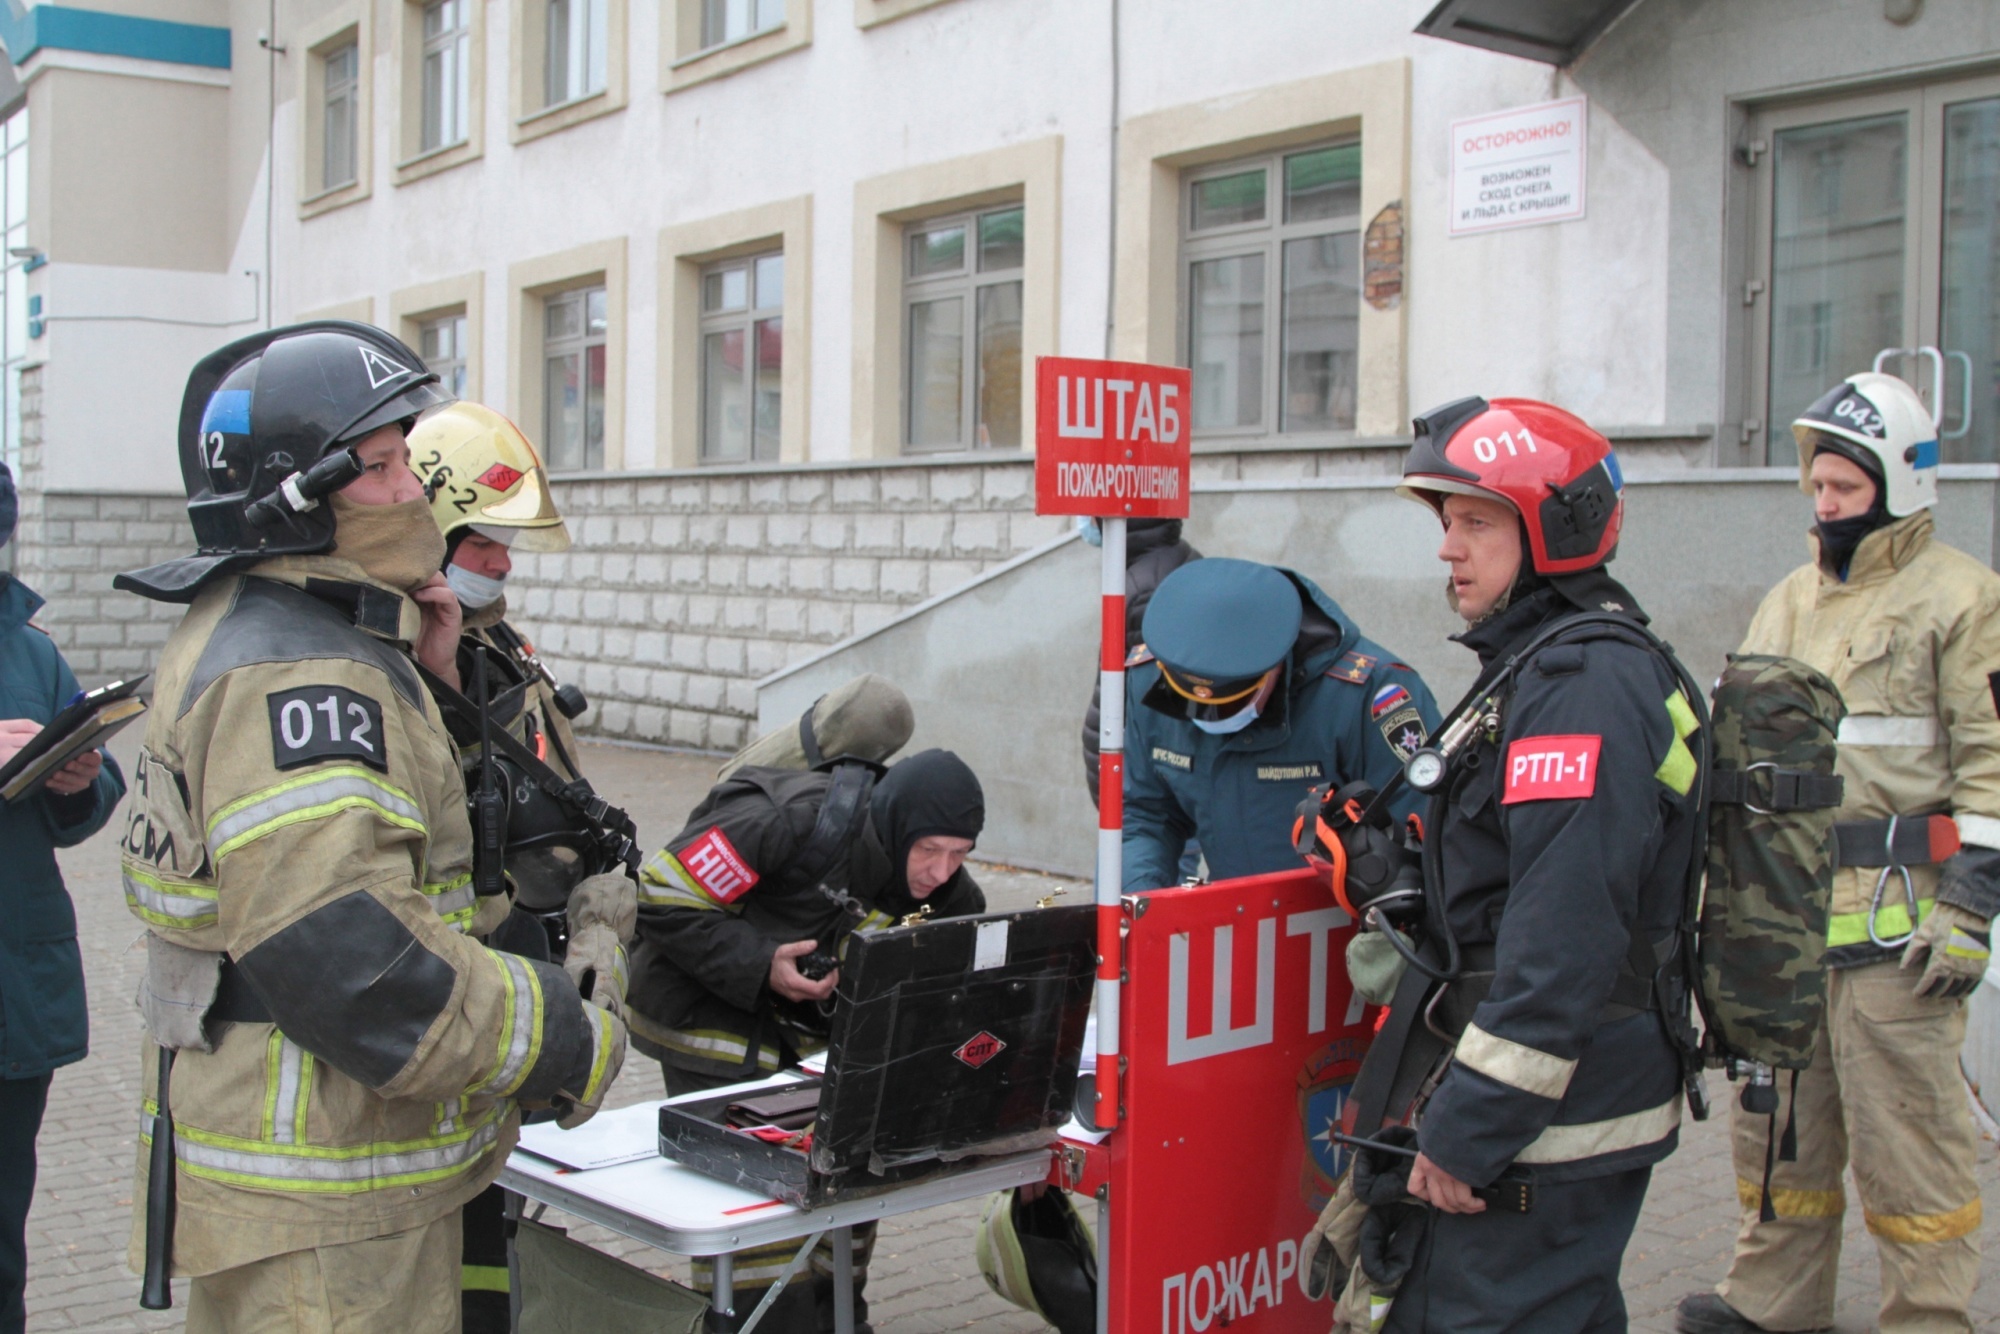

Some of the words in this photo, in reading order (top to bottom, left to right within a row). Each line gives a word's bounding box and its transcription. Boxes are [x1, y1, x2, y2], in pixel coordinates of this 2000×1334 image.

[1462, 120, 1572, 154] ОСТОРОЖНО!
[1479, 187, 1512, 203] СХОД
[1514, 181, 1553, 197] СНЕГА
[1480, 163, 1551, 187] ВОЗМОЖЕН
[1461, 210, 1470, 220] И
[1472, 204, 1506, 220] ЛЬДА
[1508, 202, 1517, 214] С
[1519, 193, 1572, 211] КРЫШИ!
[1058, 376, 1180, 444] ШТАБ
[1834, 398, 1884, 438] 042
[1473, 427, 1537, 464] 011
[418, 450, 478, 514] 26-2
[487, 470, 513, 485] СПТ
[1057, 462, 1179, 500] ПОЖАРОТУШЕНИЯ
[280, 695, 374, 752] 012
[1511, 751, 1588, 787] РТП-1
[688, 843, 742, 898] НШ
[1167, 906, 1366, 1067] ШТ
[966, 1042, 994, 1058] СПТ
